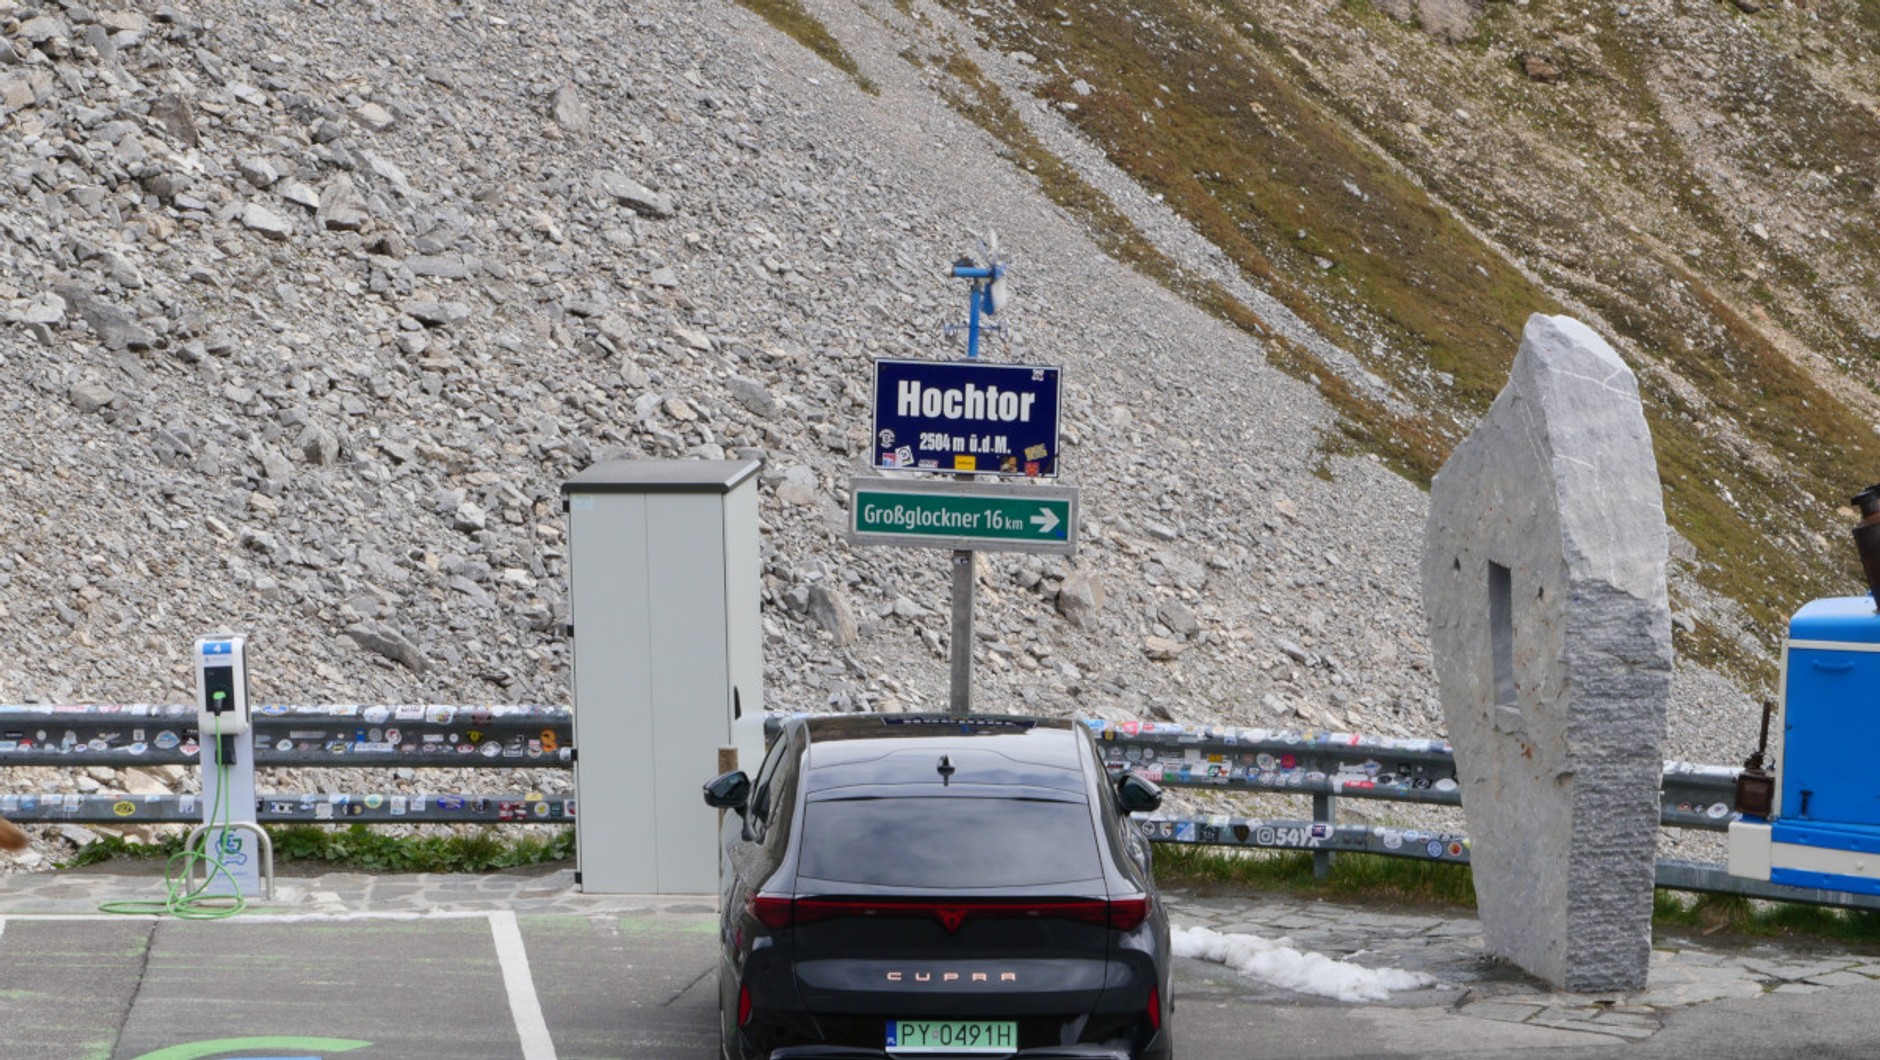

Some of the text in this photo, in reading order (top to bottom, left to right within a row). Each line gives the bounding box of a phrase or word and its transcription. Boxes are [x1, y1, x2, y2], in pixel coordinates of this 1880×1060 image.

[897, 380, 1035, 422] Hochtor
[919, 432, 1012, 454] 2504 m ü.d.M.
[864, 503, 1023, 531] Großglockner 16 km
[213, 644, 221, 652] 4
[887, 972, 1017, 982] CUPRA
[902, 1023, 1011, 1046] PY 0491H
